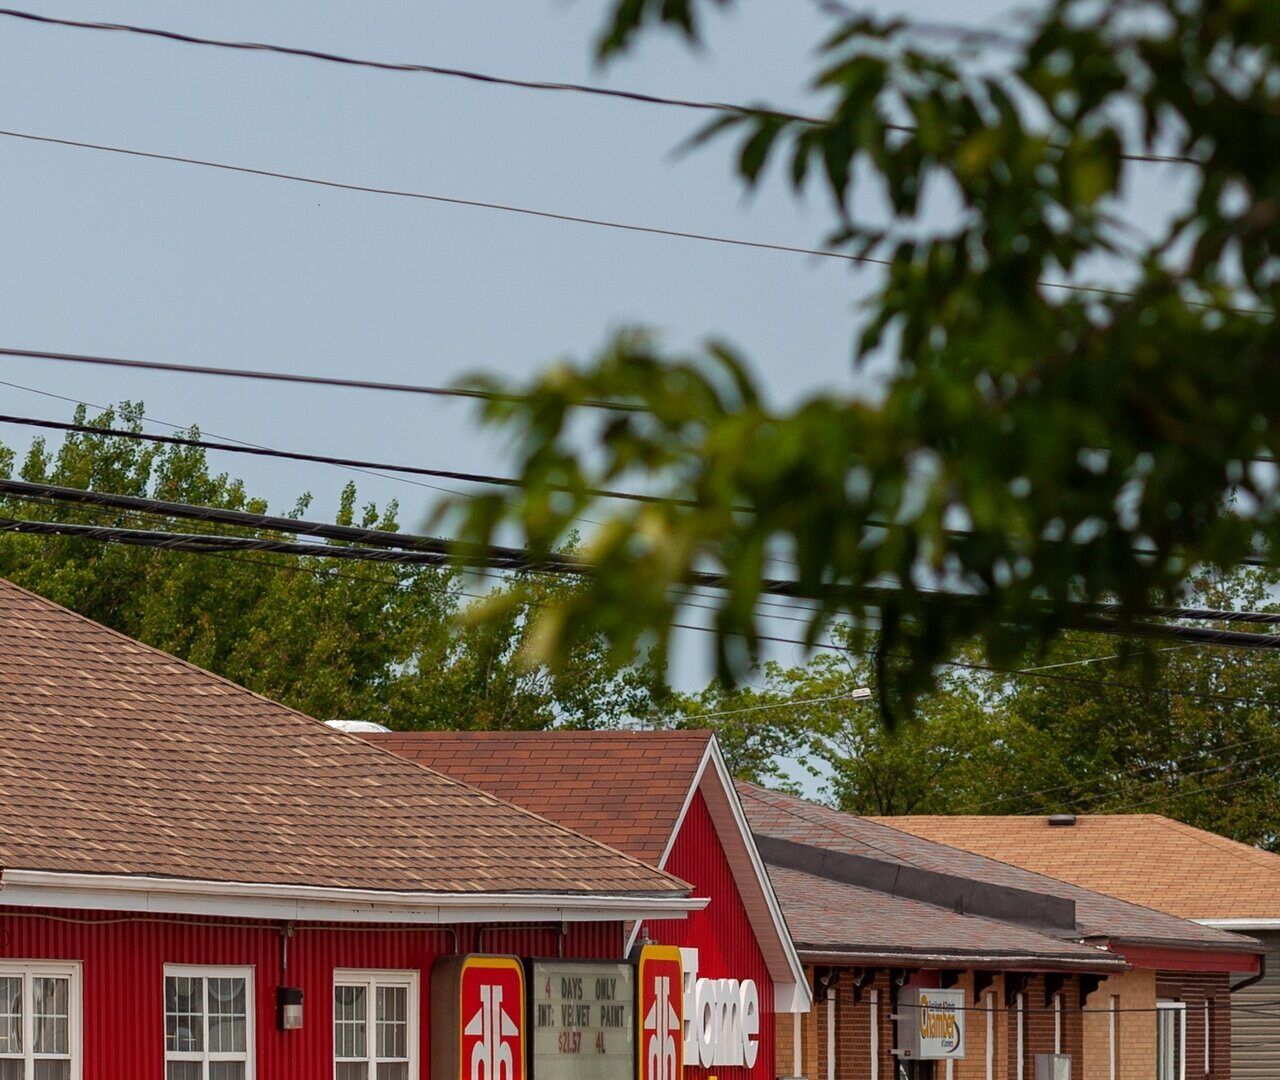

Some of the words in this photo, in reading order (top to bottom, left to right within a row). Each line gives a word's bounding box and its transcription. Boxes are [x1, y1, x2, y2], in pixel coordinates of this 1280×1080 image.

[545, 977, 551, 999] 4
[561, 977, 583, 1000] DAYS
[595, 979, 616, 1000] ONLY
[538, 1005, 554, 1027] INT:
[561, 1005, 590, 1027] VELVET
[600, 1005, 625, 1027] PAINT
[558, 1032, 582, 1054] $21.57
[595, 1032, 606, 1054] 4L
